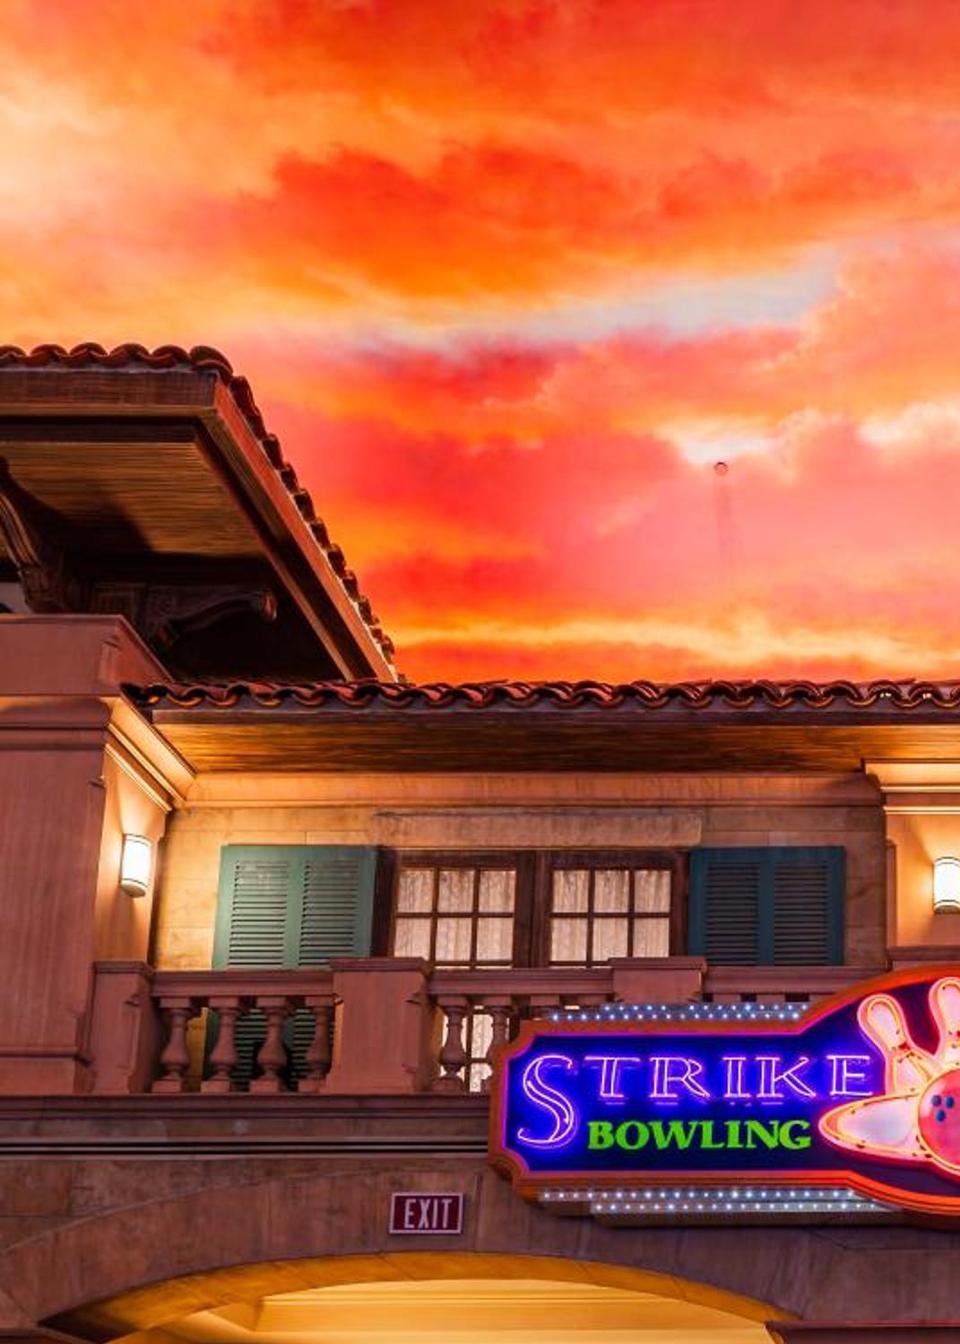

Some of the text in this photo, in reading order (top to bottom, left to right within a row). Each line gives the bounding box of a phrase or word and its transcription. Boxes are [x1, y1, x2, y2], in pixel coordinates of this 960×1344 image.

[517, 1053, 874, 1150] STRIKE
[587, 1119, 812, 1150] BOWLING
[404, 1198, 453, 1230] EXIT
